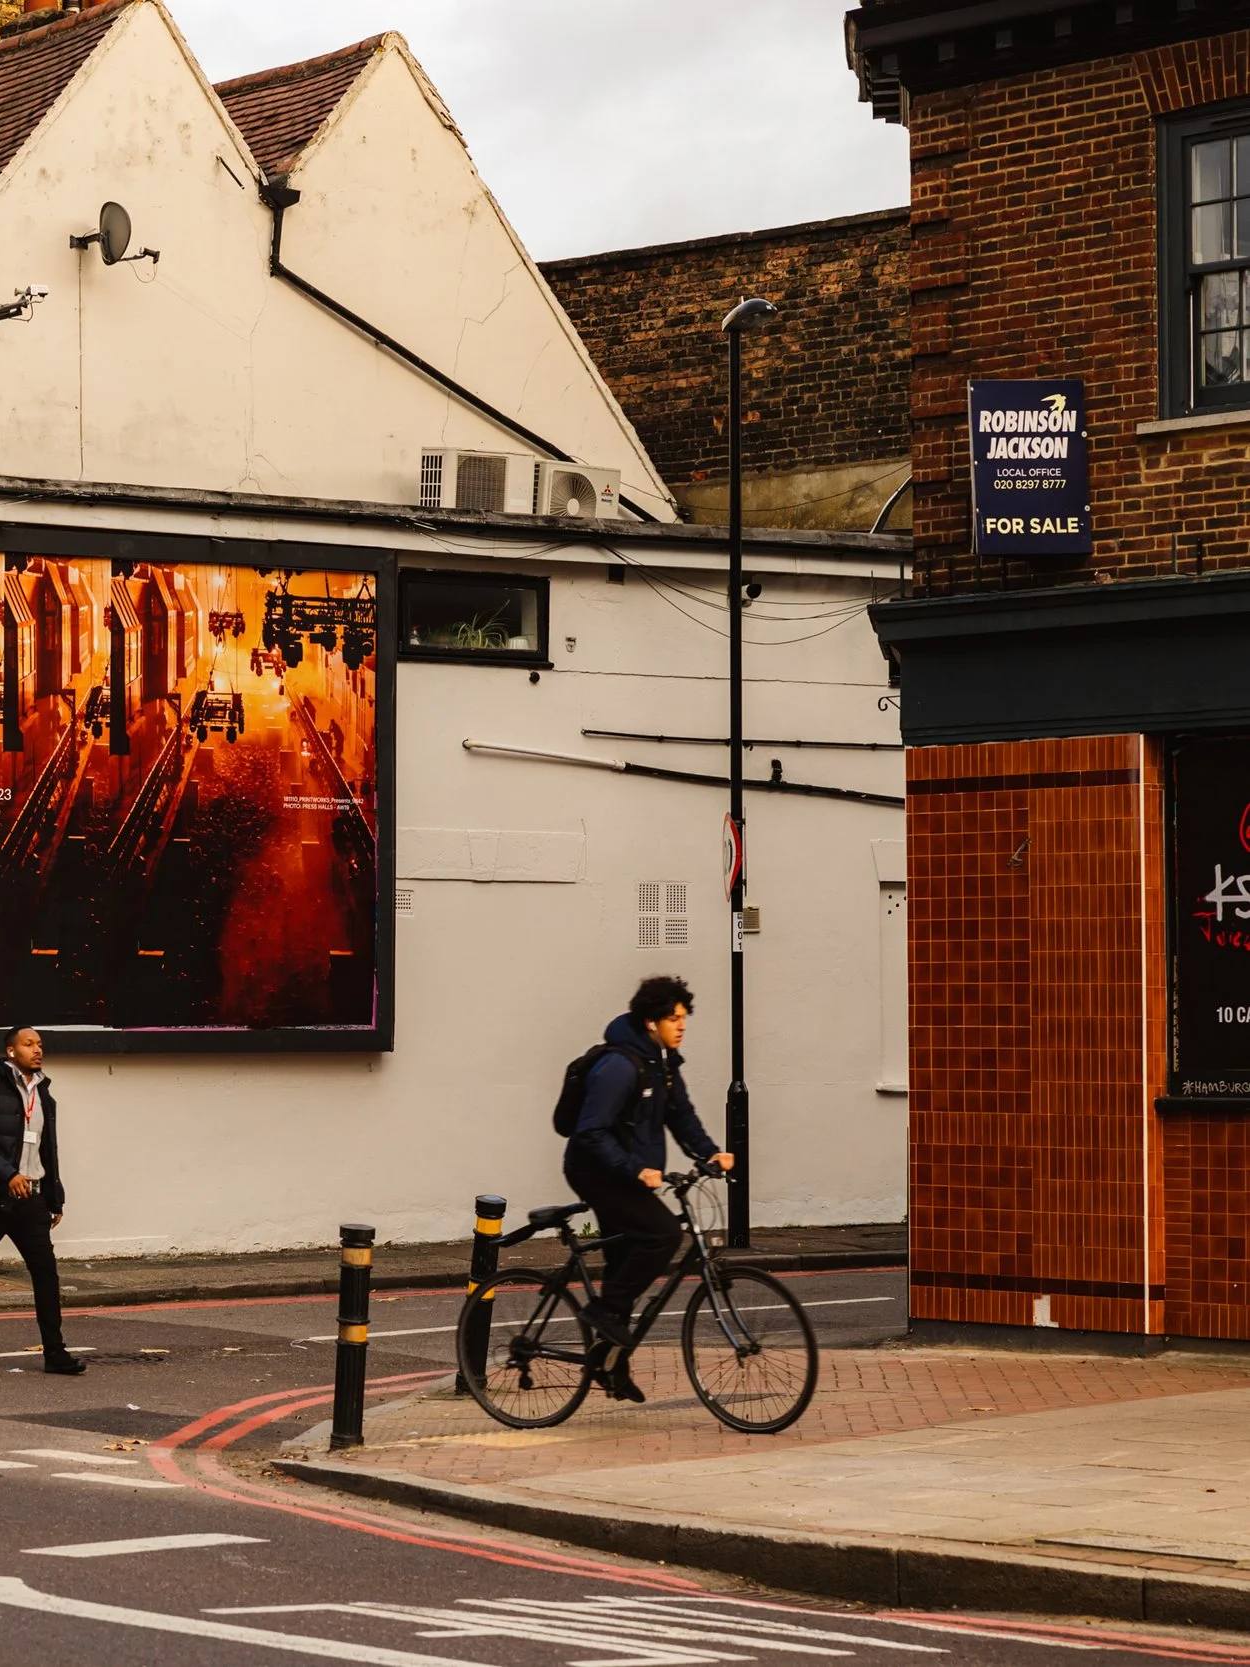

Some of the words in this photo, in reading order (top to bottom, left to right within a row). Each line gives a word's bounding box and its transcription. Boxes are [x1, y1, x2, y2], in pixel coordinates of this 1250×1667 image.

[979, 410, 1077, 433] ROBINSON
[986, 437, 1069, 459] JACKSON
[997, 468, 1027, 477] LOCAL
[1029, 468, 1062, 477] OFFICE
[994, 480, 1014, 490] 020
[1015, 480, 1040, 490] 8297
[1042, 480, 1066, 489] 8777
[986, 518, 1025, 534] FOR
[1030, 517, 1079, 534] SALE
[1216, 1006, 1234, 1023] 10
